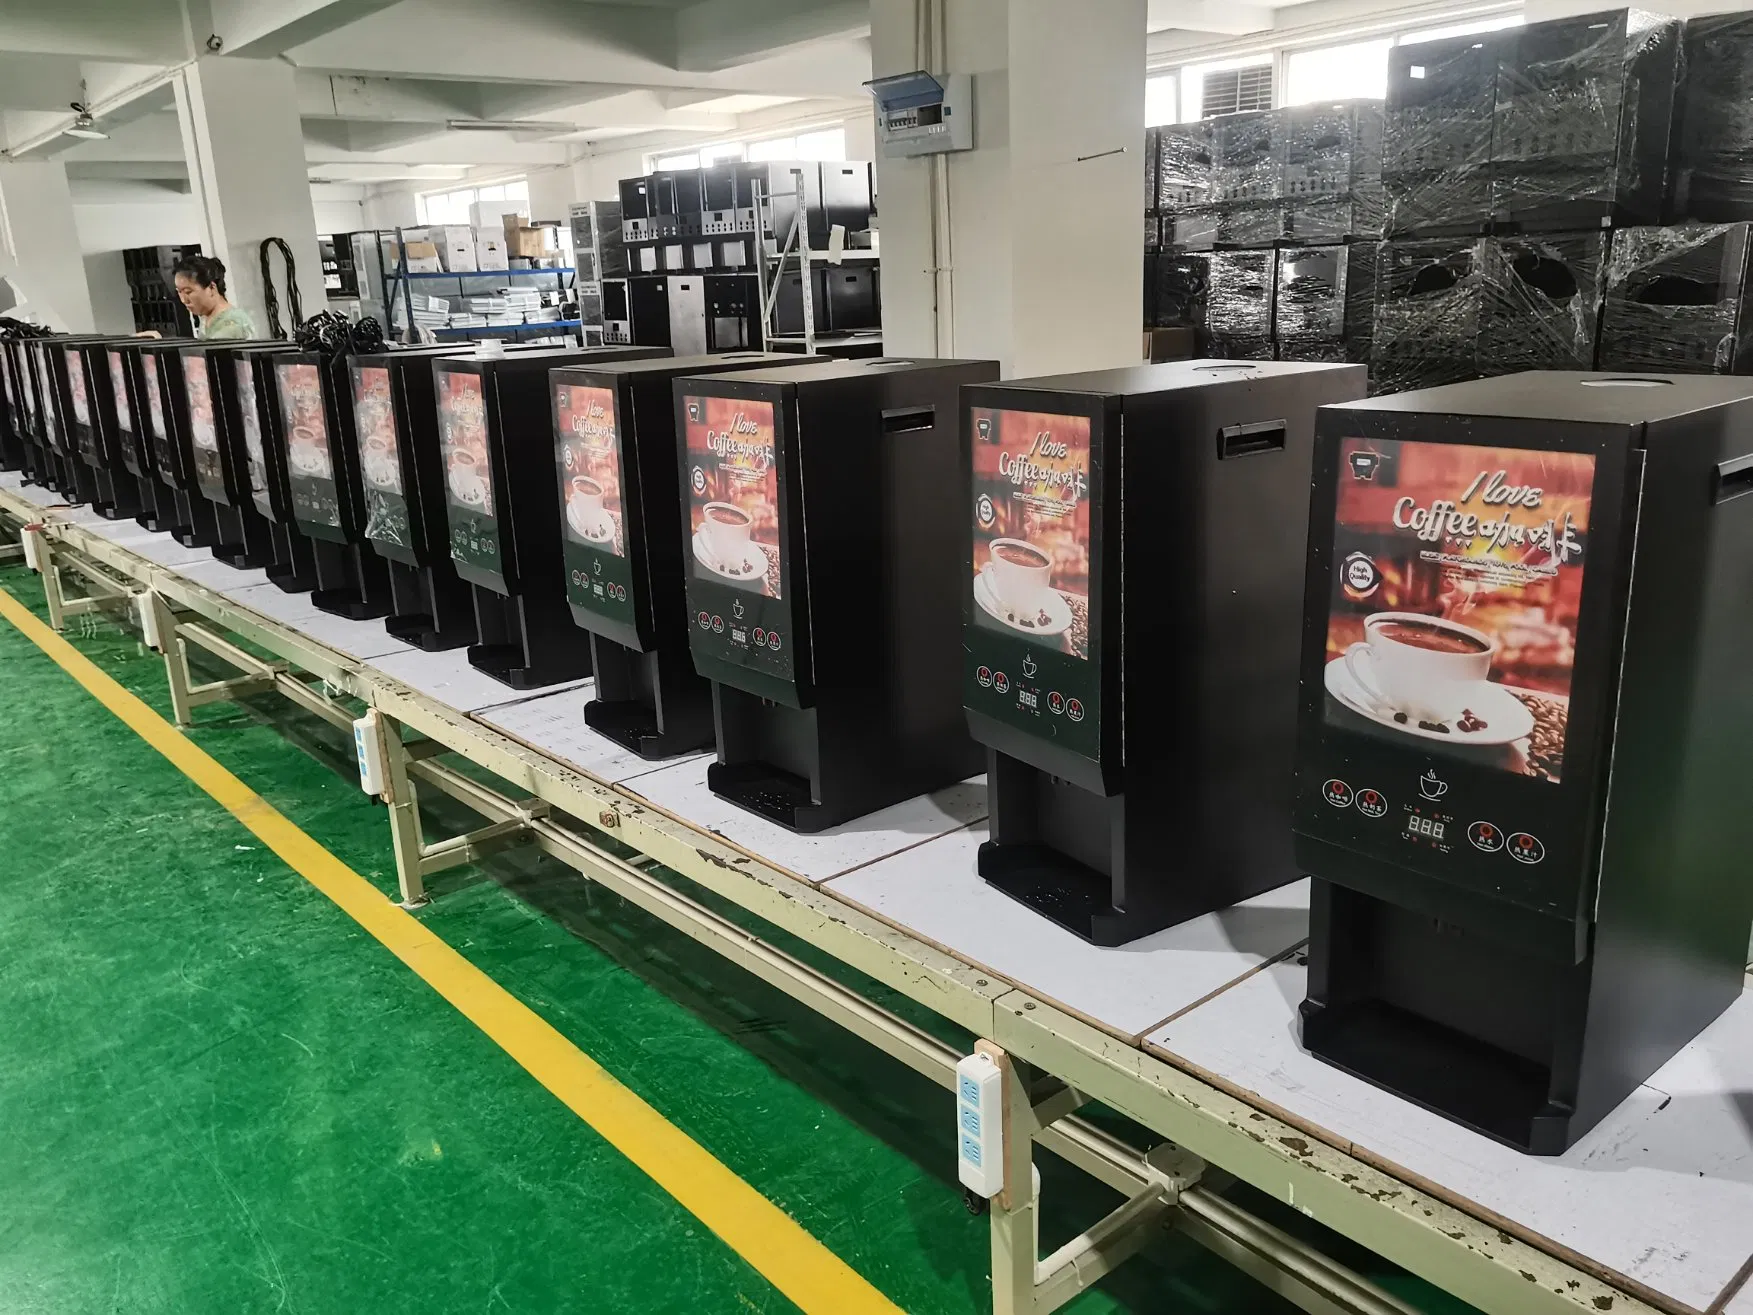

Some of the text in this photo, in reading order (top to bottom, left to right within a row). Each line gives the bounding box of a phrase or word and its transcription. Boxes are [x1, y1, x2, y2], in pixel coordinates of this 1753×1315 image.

[738, 412, 758, 436] love
[707, 430, 737, 458] Coffee
[1040, 431, 1068, 460] love
[999, 451, 1039, 485] Coffee
[1460, 469, 1544, 508] I love
[1392, 495, 1477, 542] Coffee
[1349, 572, 1371, 582] Quality
[1353, 565, 1368, 574] High
